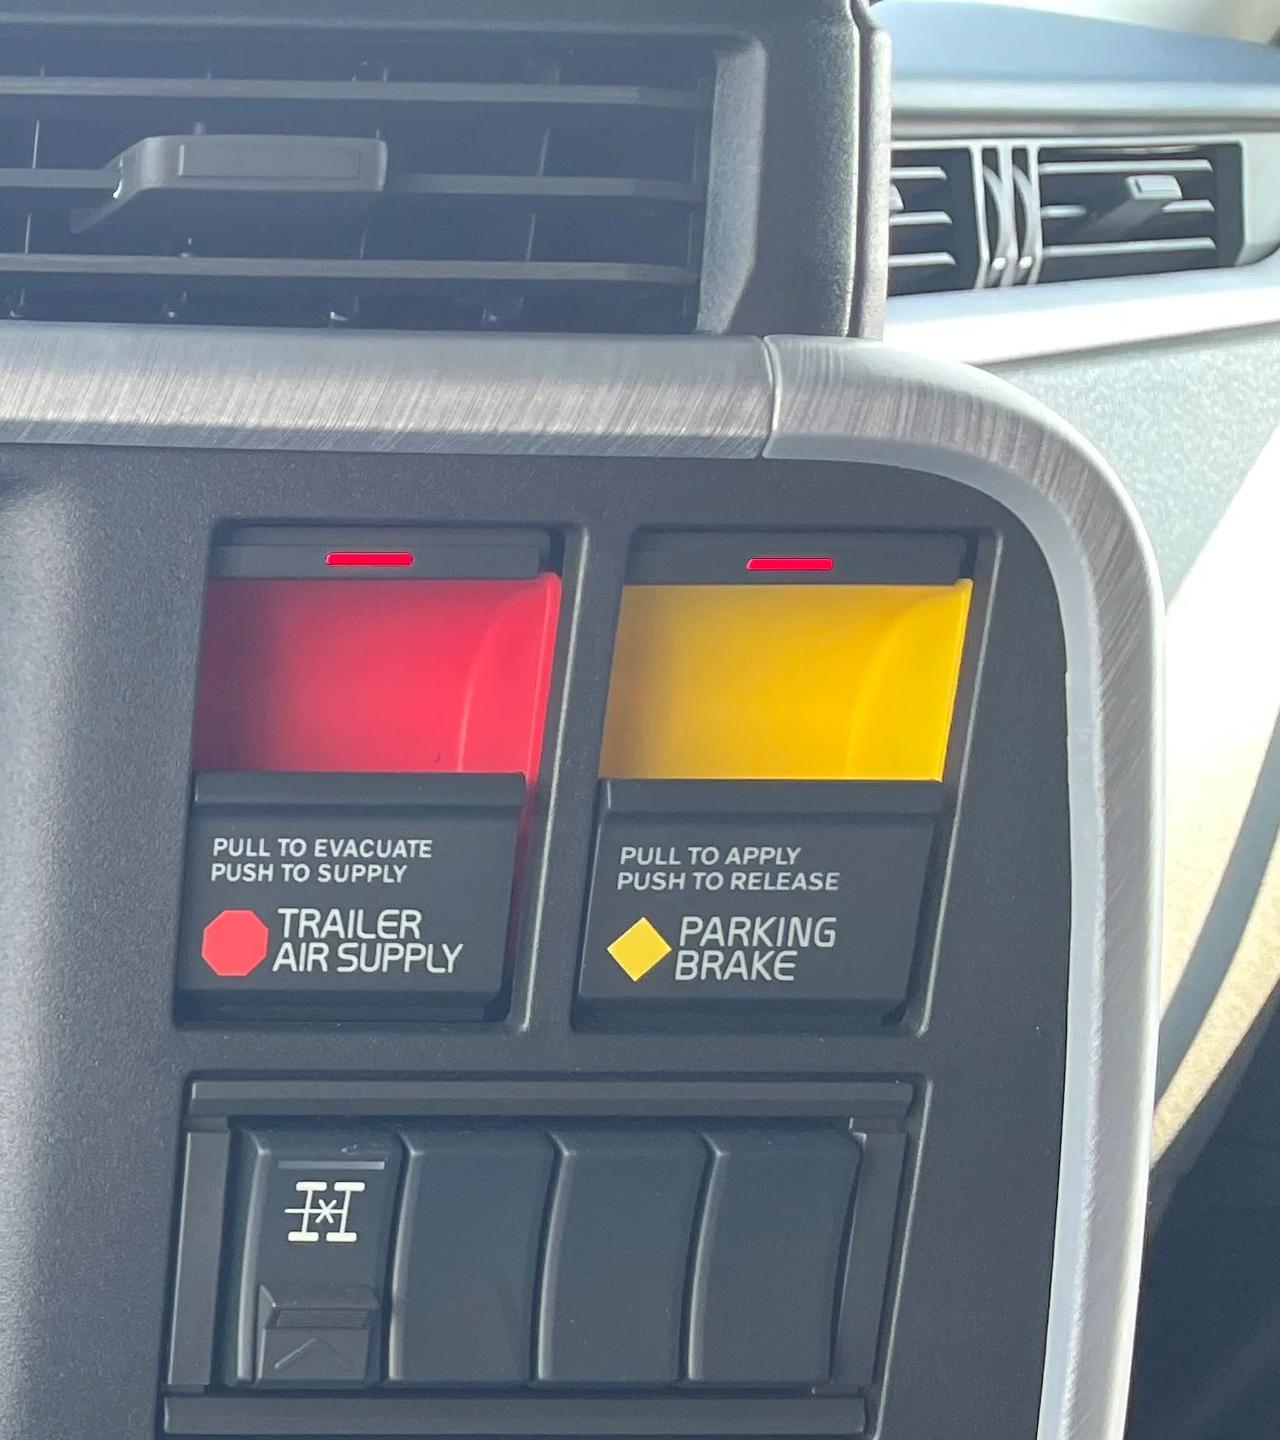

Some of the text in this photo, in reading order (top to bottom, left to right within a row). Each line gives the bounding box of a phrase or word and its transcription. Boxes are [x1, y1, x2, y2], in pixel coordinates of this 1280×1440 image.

[213, 837, 433, 859] PULL TO EVACUATE
[620, 846, 802, 866] PULL TO APPLY
[211, 862, 408, 883] PUSH TO SUPPLY
[617, 870, 841, 892] PUSH TO RELEASE
[277, 907, 422, 940] TRAILER
[679, 916, 838, 948] PARKING
[272, 941, 464, 974] AIR SUPPLY
[674, 950, 798, 982] BRAKE
